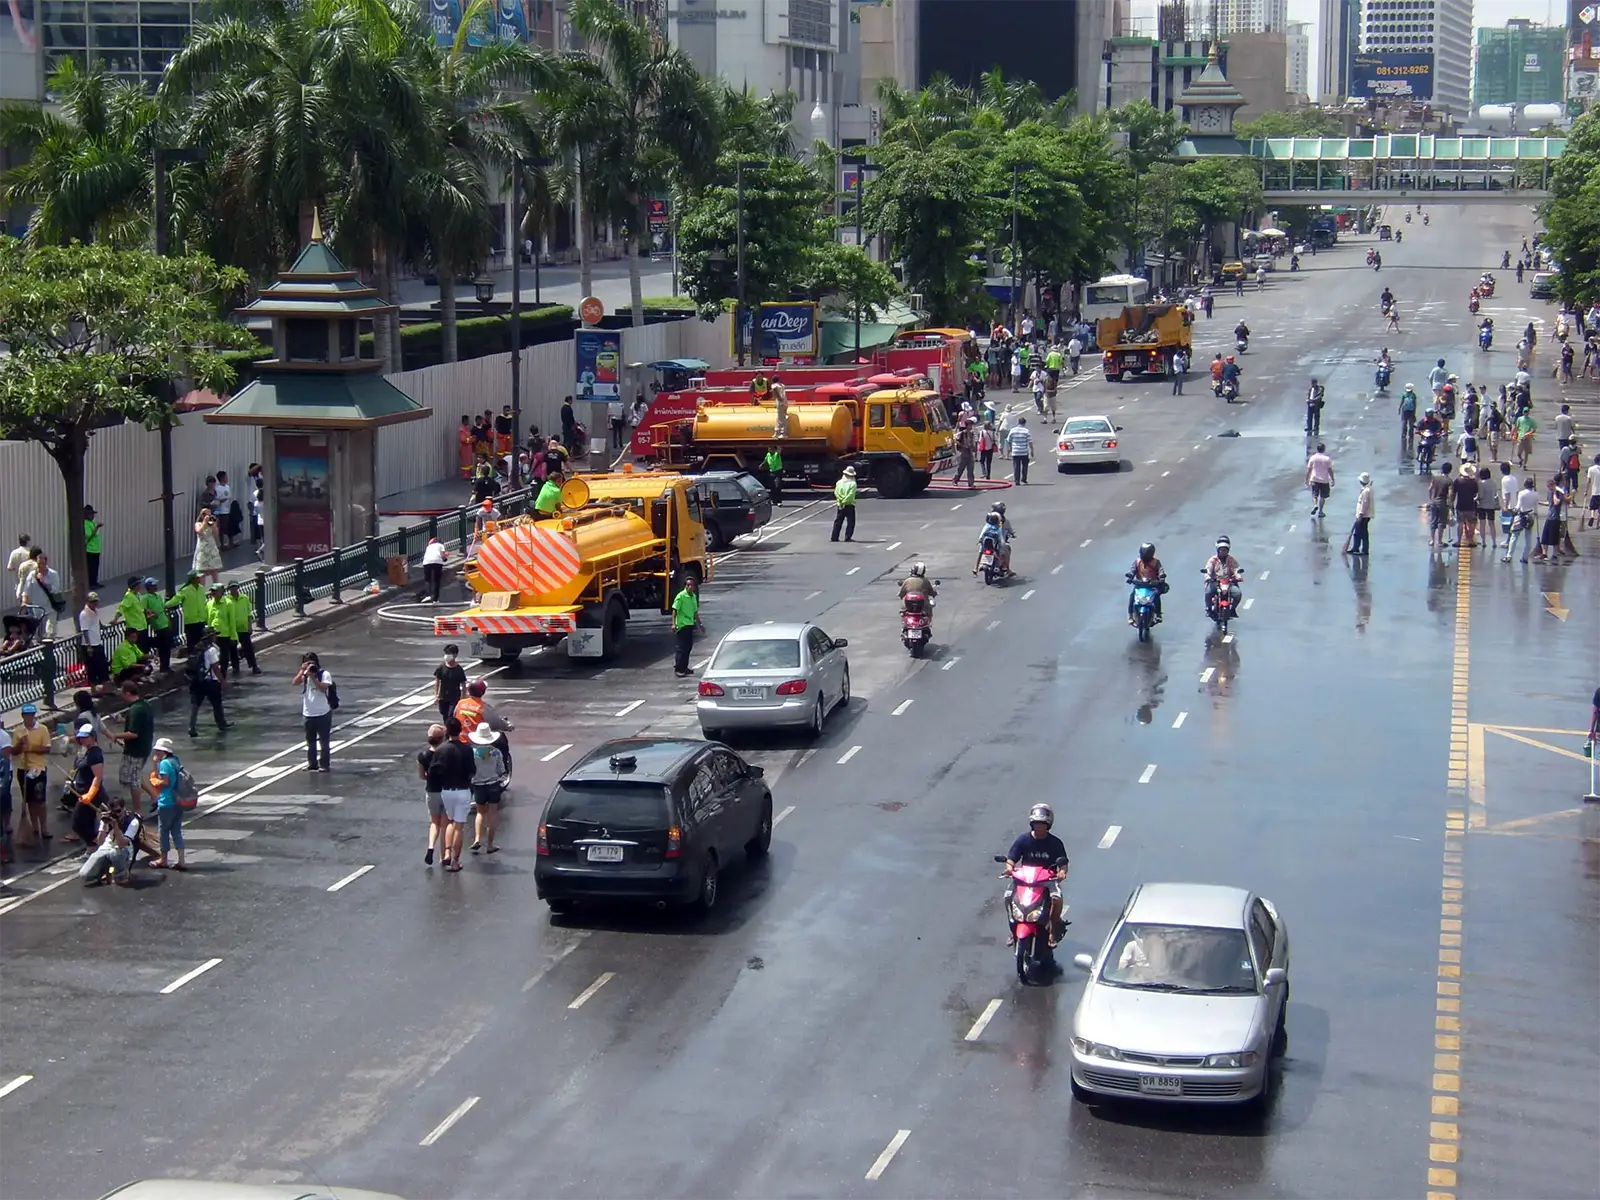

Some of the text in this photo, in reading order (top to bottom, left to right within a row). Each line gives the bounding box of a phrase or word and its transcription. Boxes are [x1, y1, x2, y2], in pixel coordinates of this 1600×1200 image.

[1376, 65, 1429, 75] 081-312-9262
[306, 543, 329, 552] VISA
[1158, 1077, 1180, 1087] 8859
